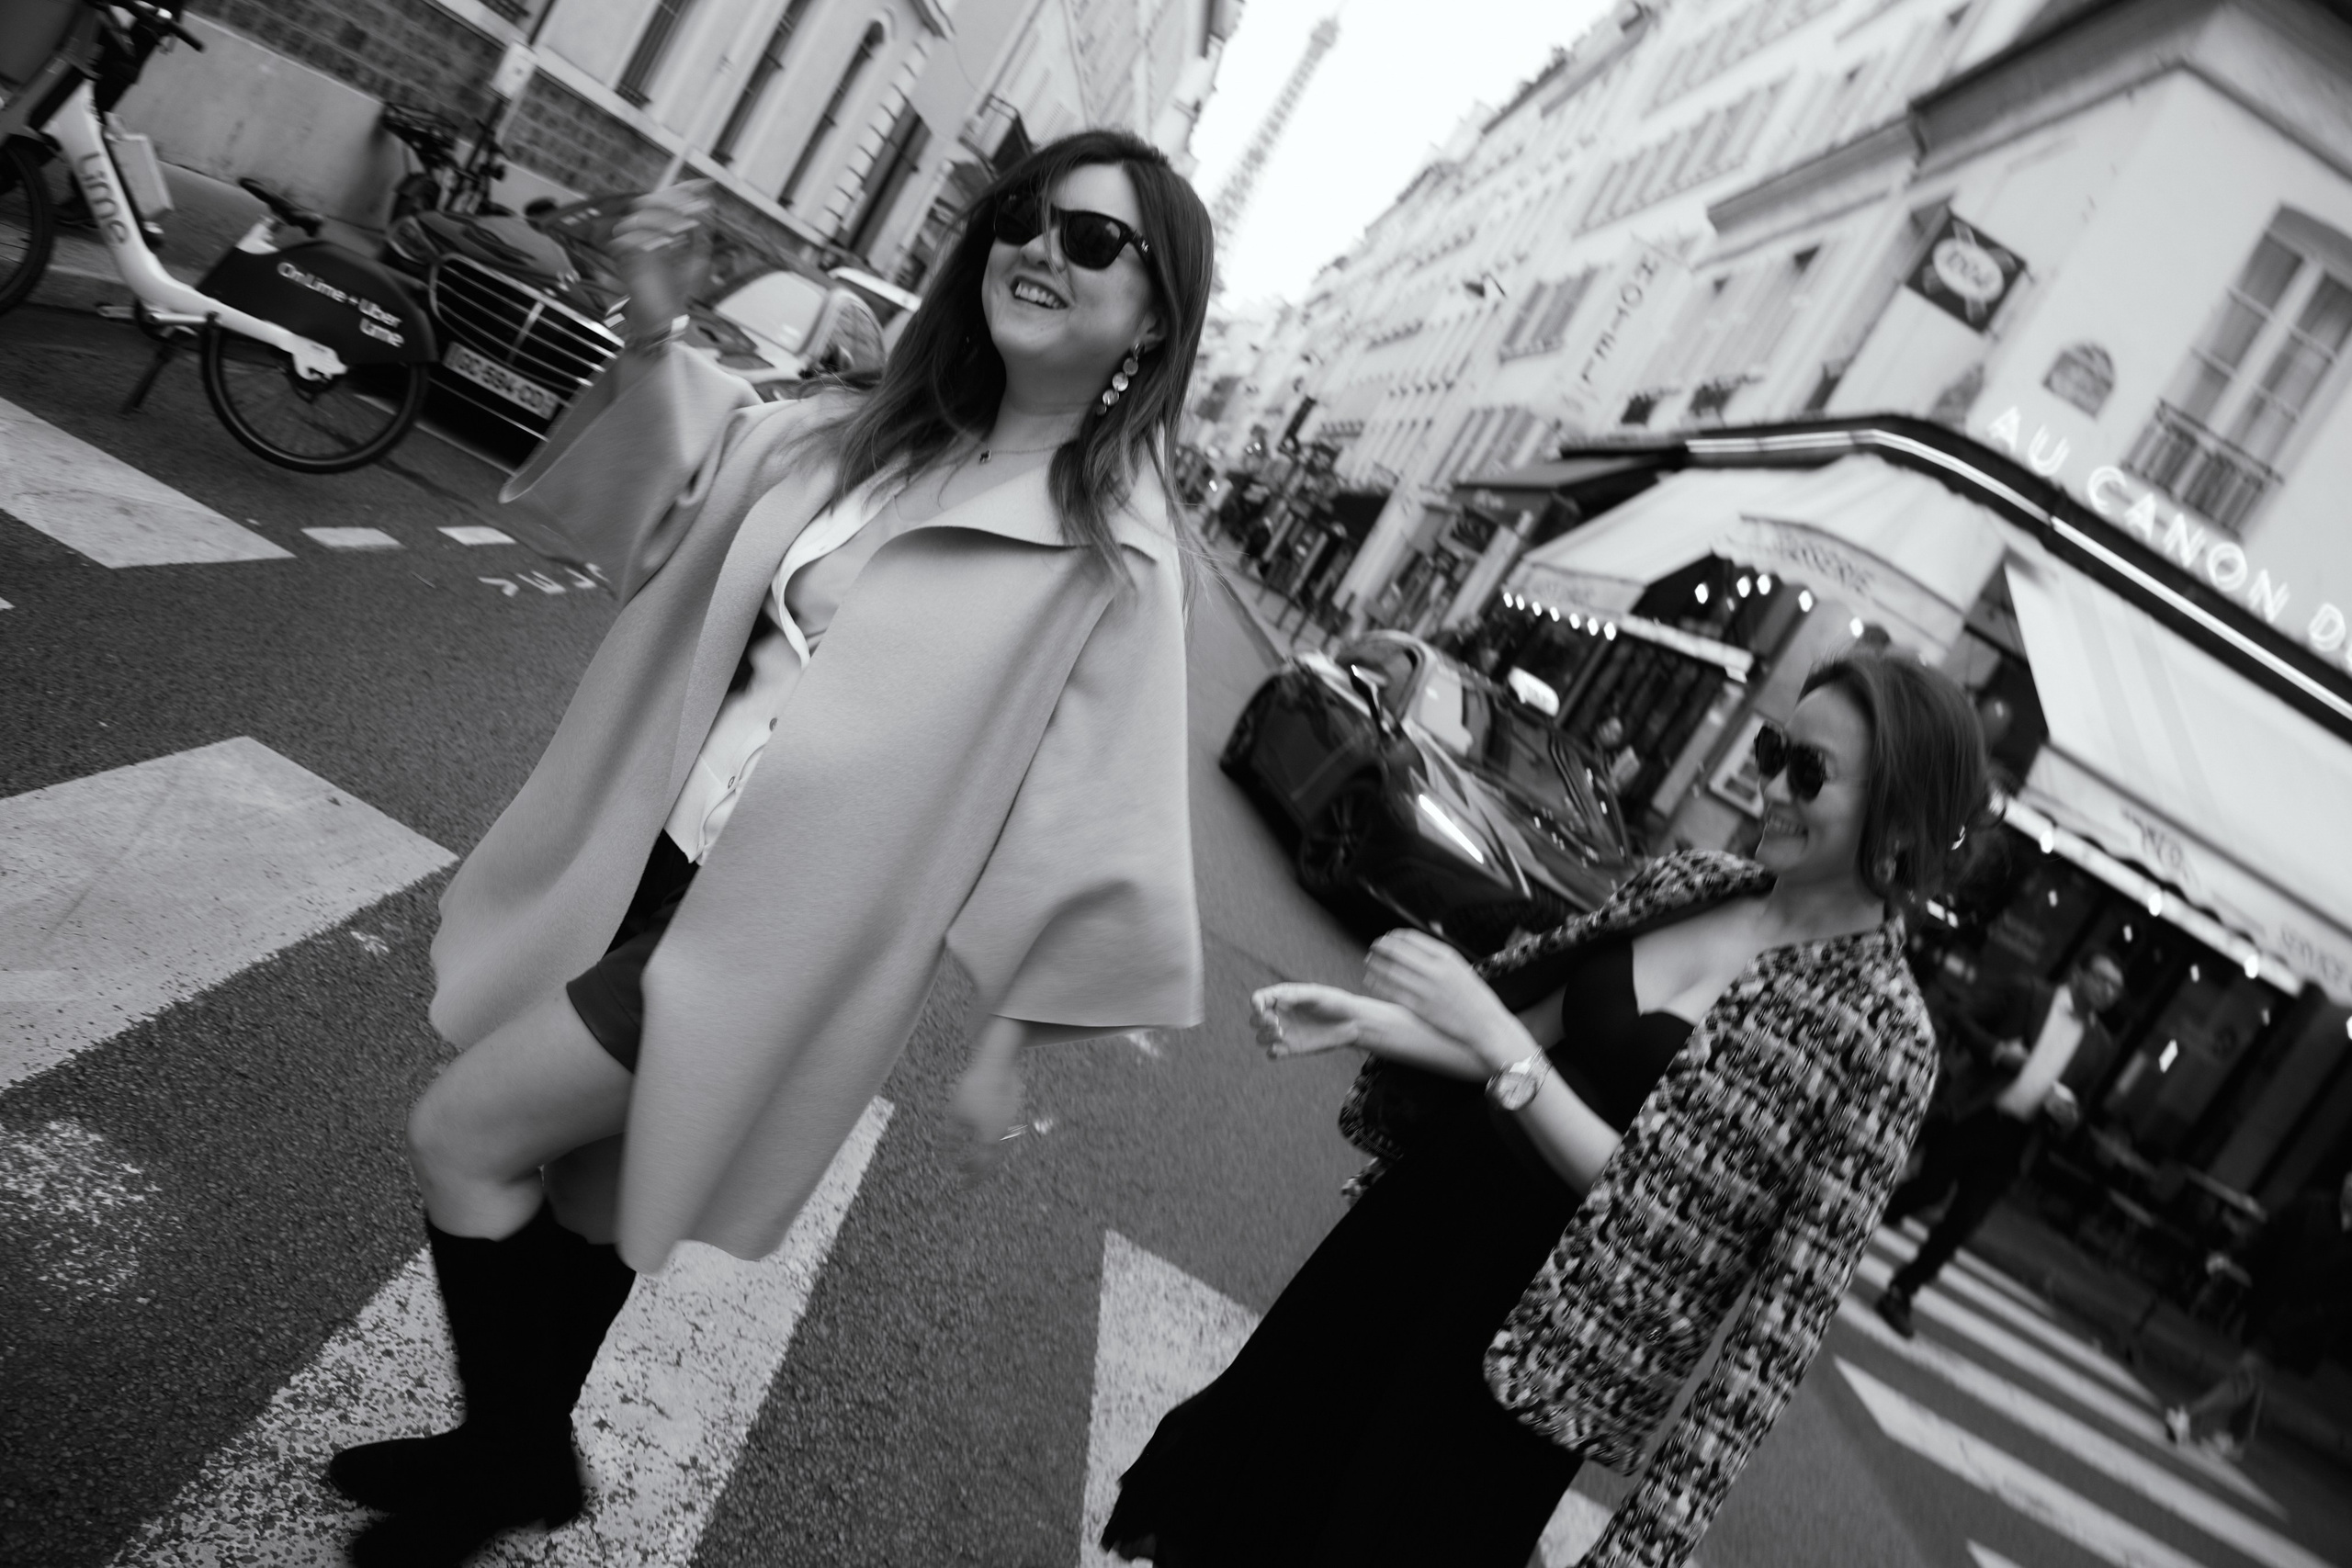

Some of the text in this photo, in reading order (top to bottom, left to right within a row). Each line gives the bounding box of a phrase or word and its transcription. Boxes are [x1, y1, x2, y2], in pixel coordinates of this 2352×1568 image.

[79, 149, 130, 245] Lime
[358, 298, 402, 328] Uber
[1985, 405, 2071, 477] AU
[2086, 464, 2291, 625] CANON
